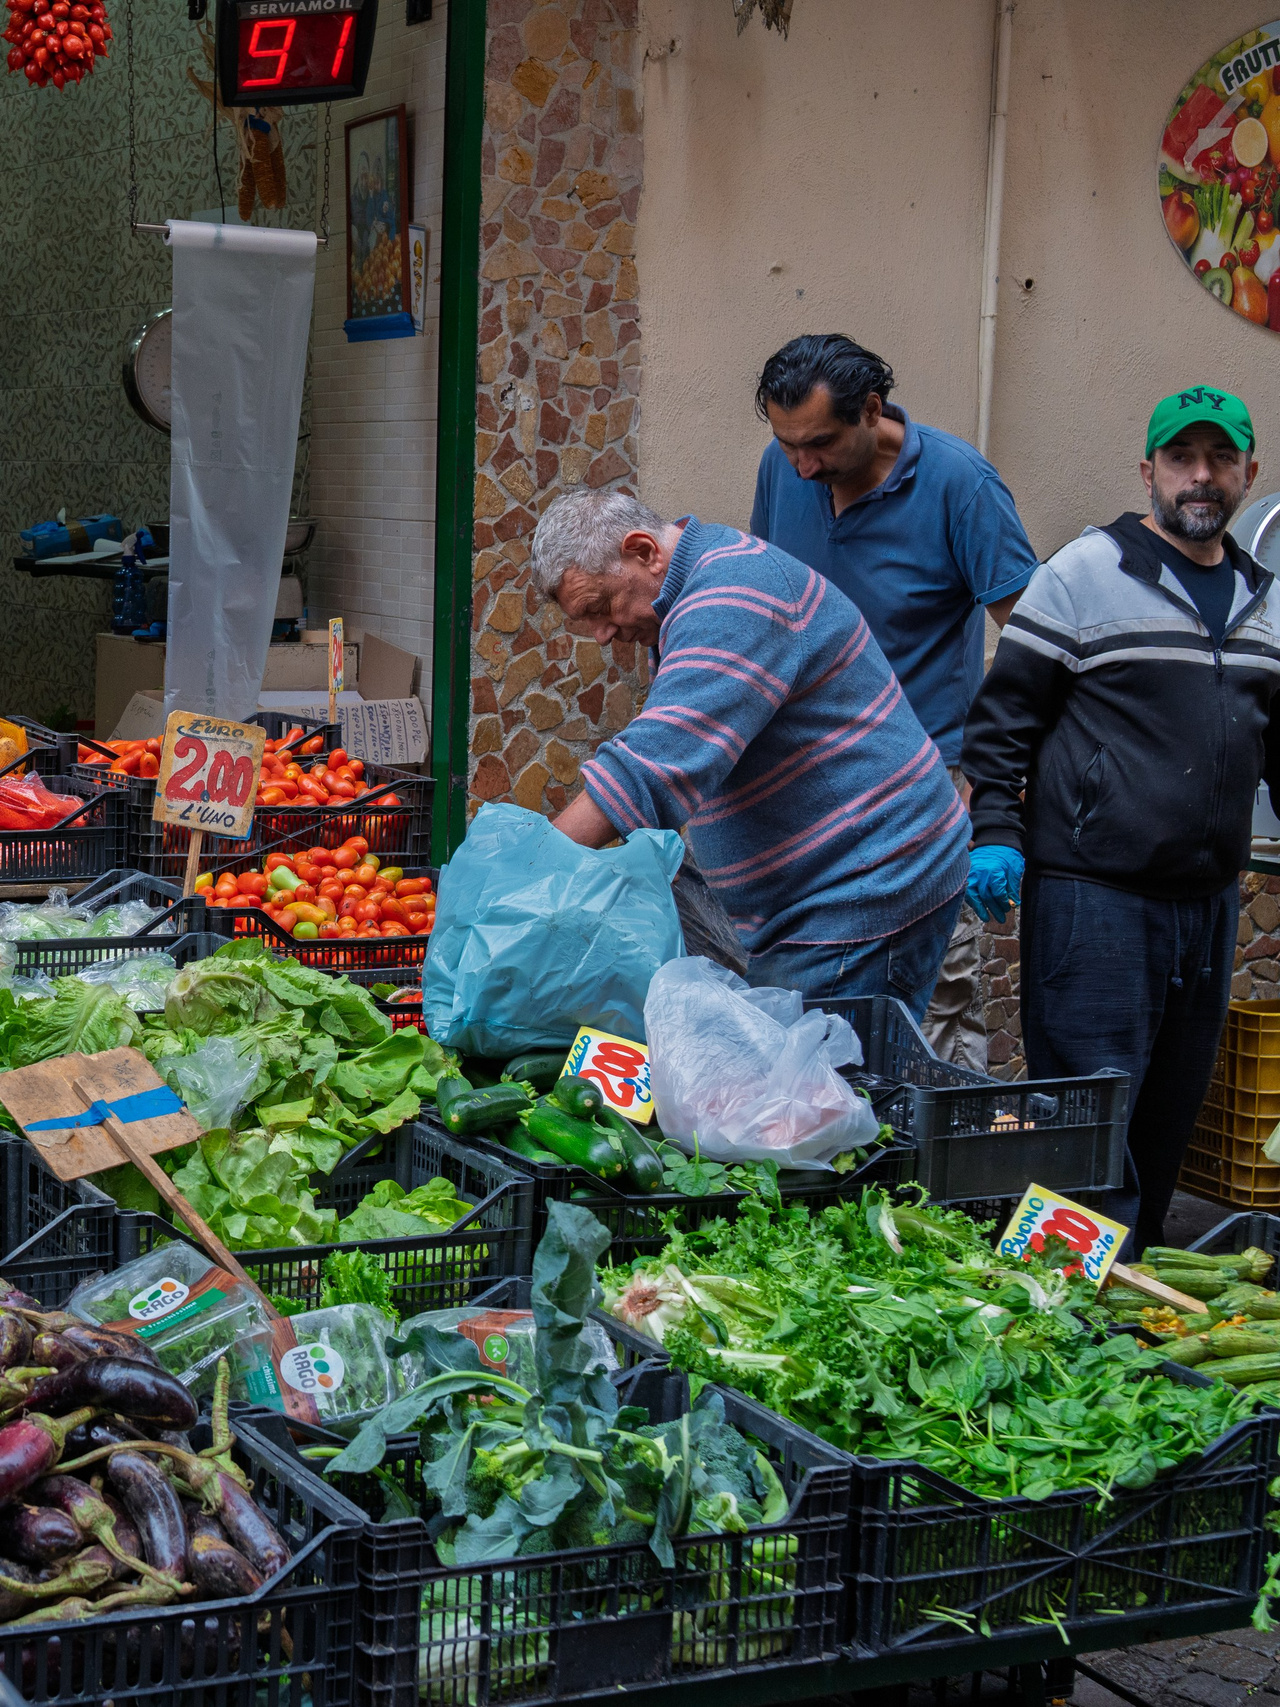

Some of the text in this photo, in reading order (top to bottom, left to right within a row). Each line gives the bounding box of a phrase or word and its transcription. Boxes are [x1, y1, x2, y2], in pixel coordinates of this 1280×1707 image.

[249, 0, 353, 15] SERVIAMO IL
[242, 16, 354, 87] 91
[1177, 387, 1227, 412] NY
[179, 803, 236, 828] L'UNO
[1000, 1197, 1045, 1260] BUONO
[1084, 1233, 1115, 1281] Chilo
[138, 1290, 186, 1318] RAGO
[291, 1350, 317, 1389] RAGO
